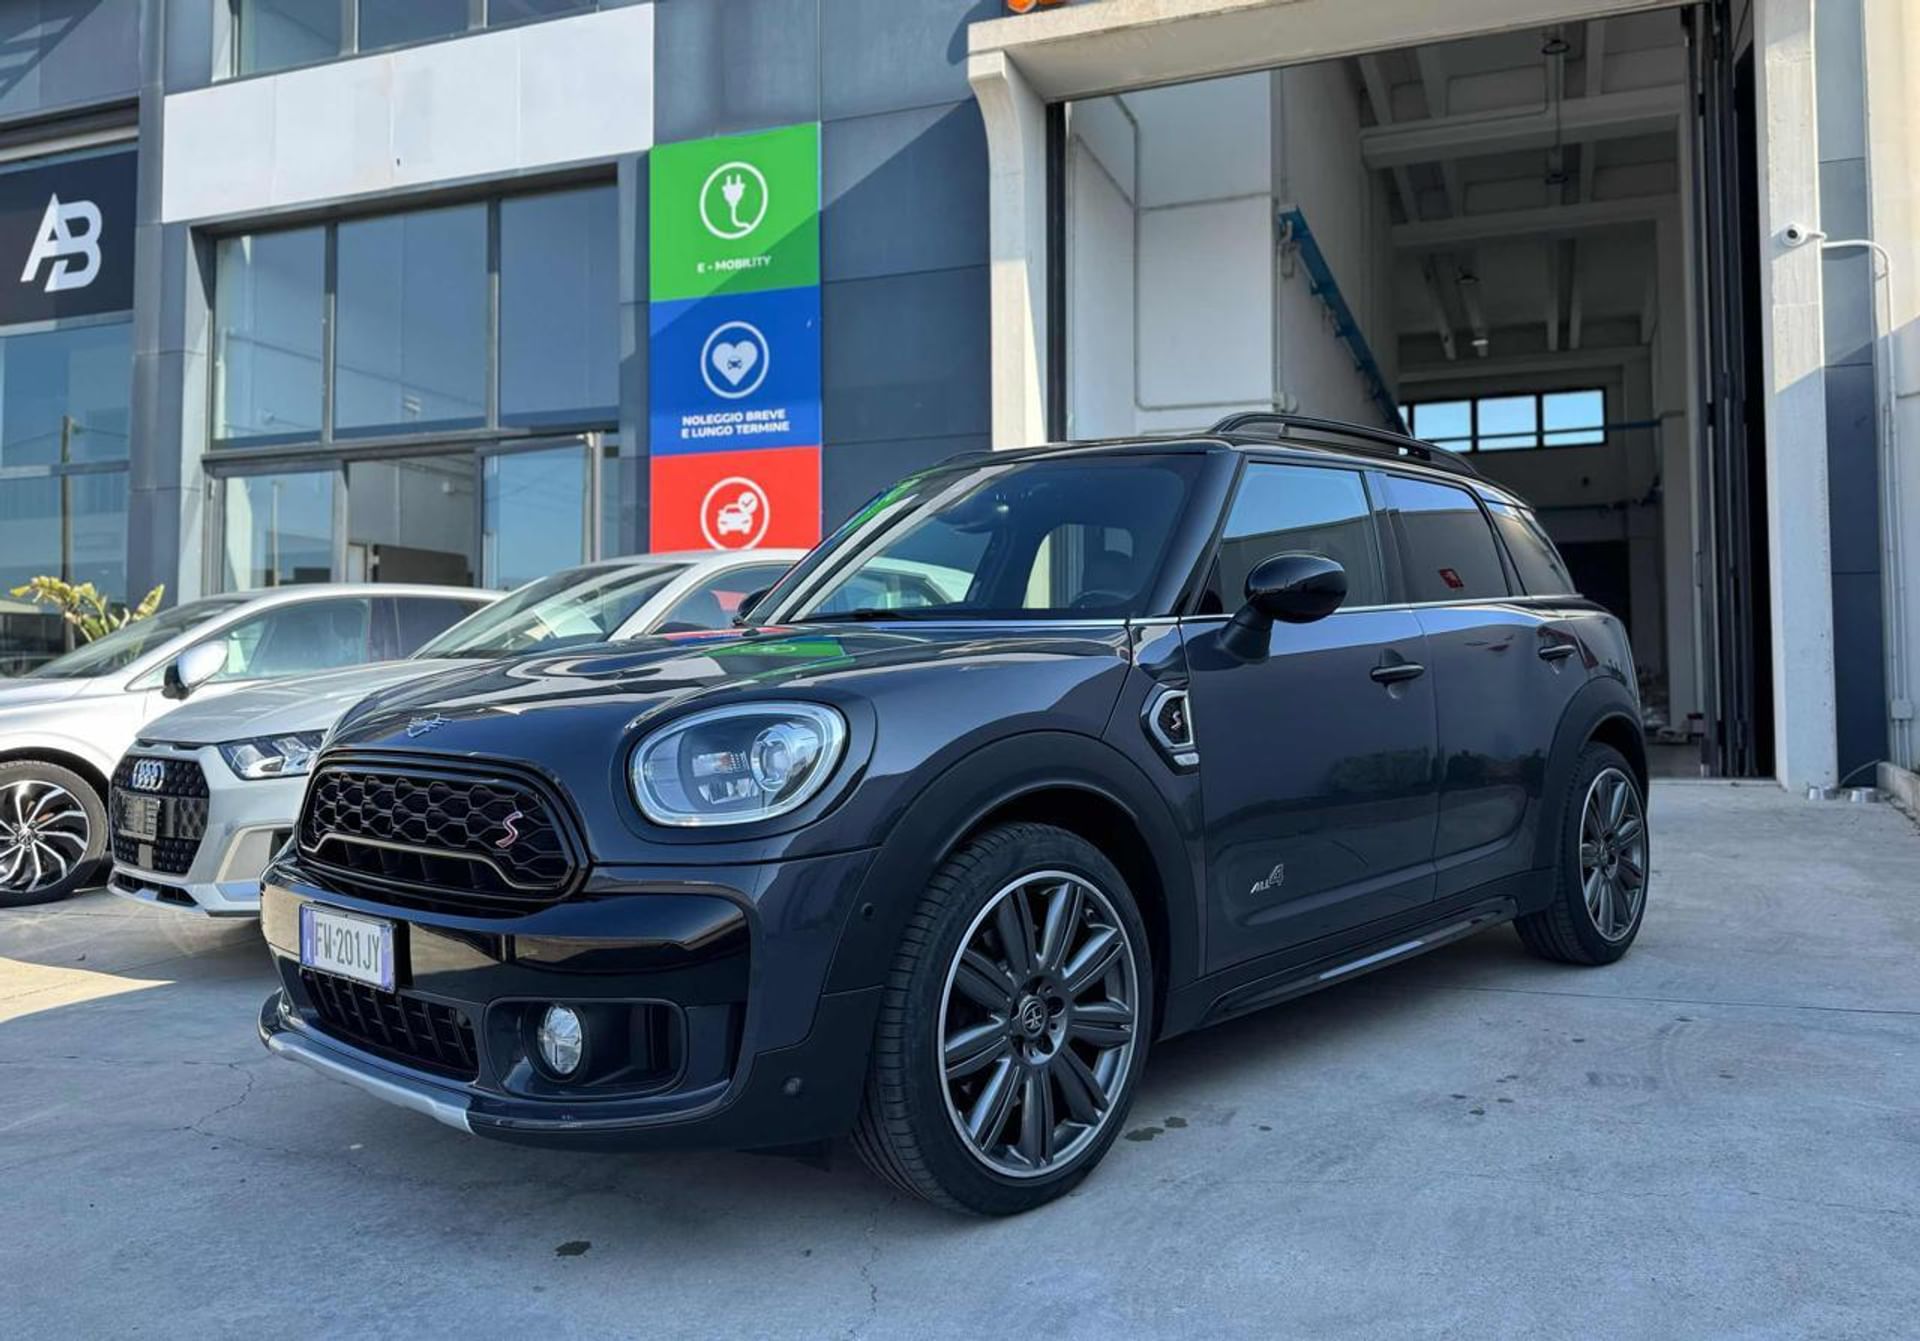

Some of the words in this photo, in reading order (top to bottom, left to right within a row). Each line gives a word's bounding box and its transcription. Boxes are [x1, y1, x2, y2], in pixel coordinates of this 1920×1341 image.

[20, 191, 103, 293] AB
[697, 262, 705, 274] E
[715, 255, 772, 271] MOBILITY
[682, 412, 743, 426] NOLEGGIO
[745, 408, 786, 422] BREVE
[681, 428, 690, 439] E
[691, 425, 733, 439] LUNGO
[735, 421, 790, 435] TERMINE
[495, 810, 524, 849] S
